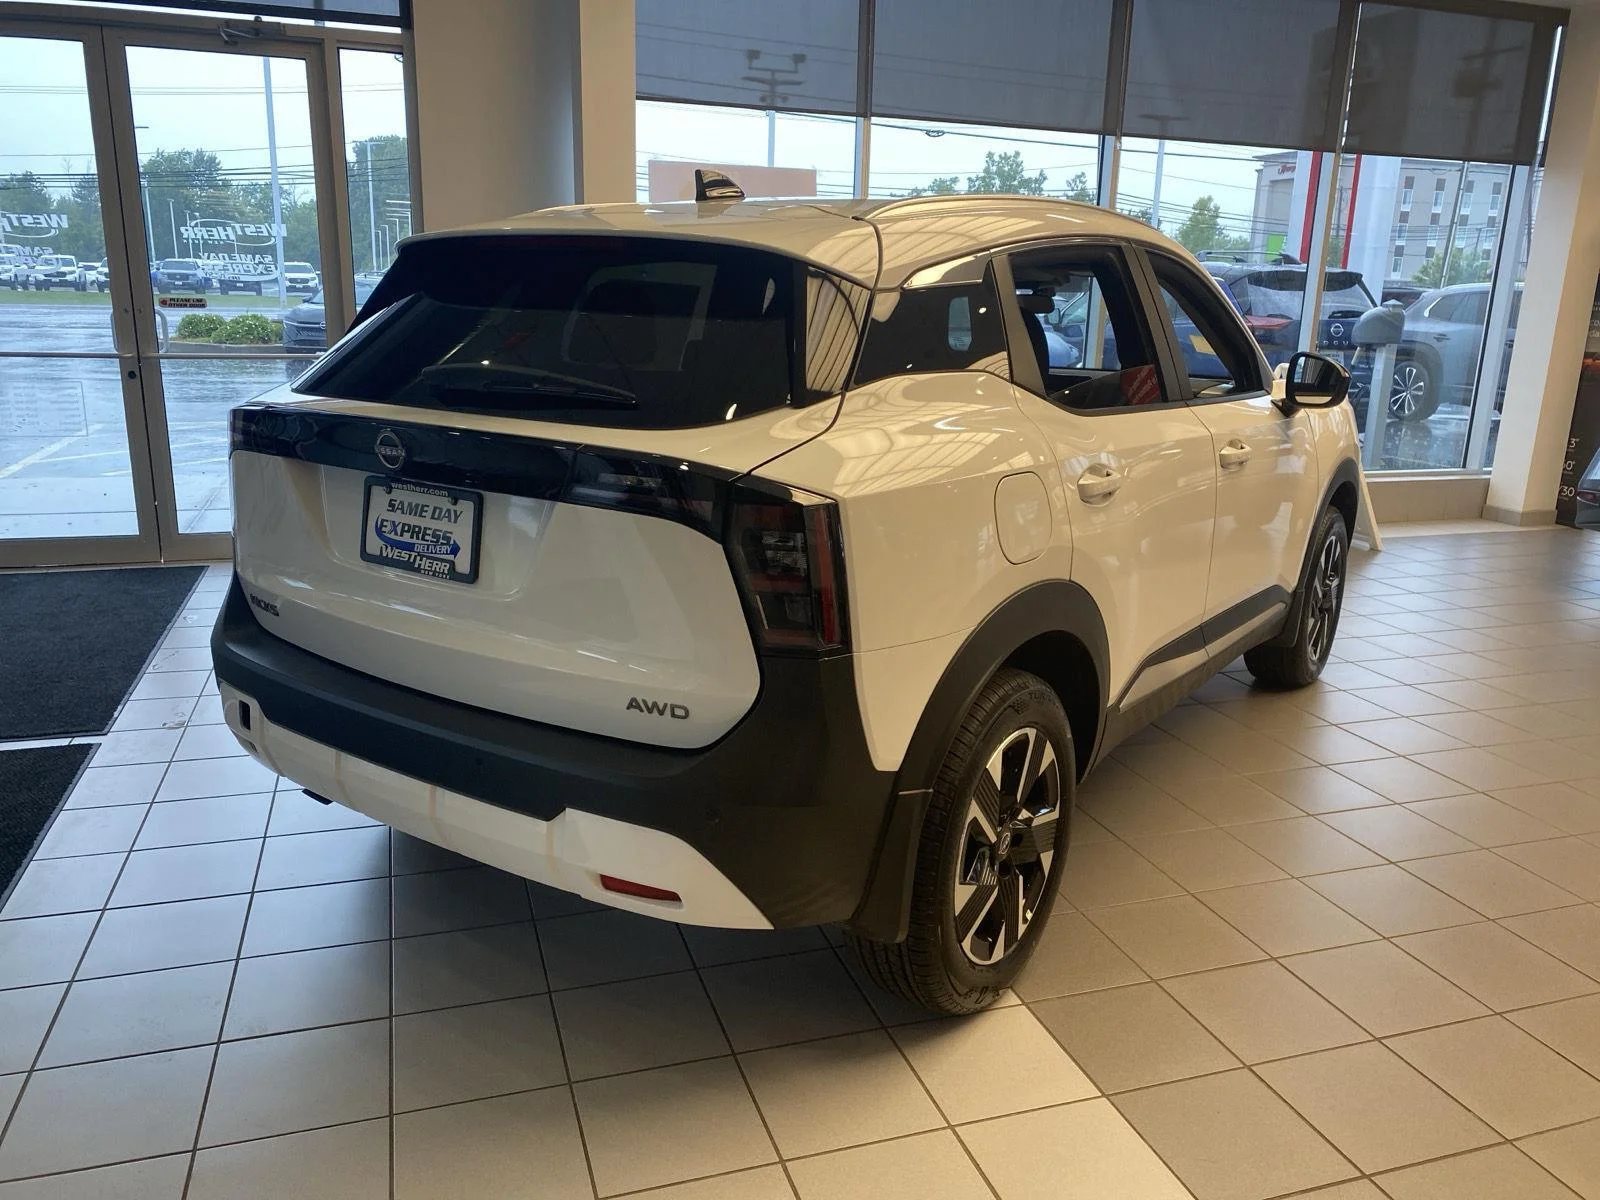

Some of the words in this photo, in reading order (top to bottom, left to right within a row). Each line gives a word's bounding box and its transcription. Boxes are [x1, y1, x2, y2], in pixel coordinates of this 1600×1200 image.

[391, 482, 449, 497] westherr.com
[387, 498, 430, 518] SAME
[430, 505, 464, 524] DAY
[379, 518, 454, 546] EXPRESS
[414, 543, 452, 554] DELIVERY
[626, 696, 690, 720] AWD
